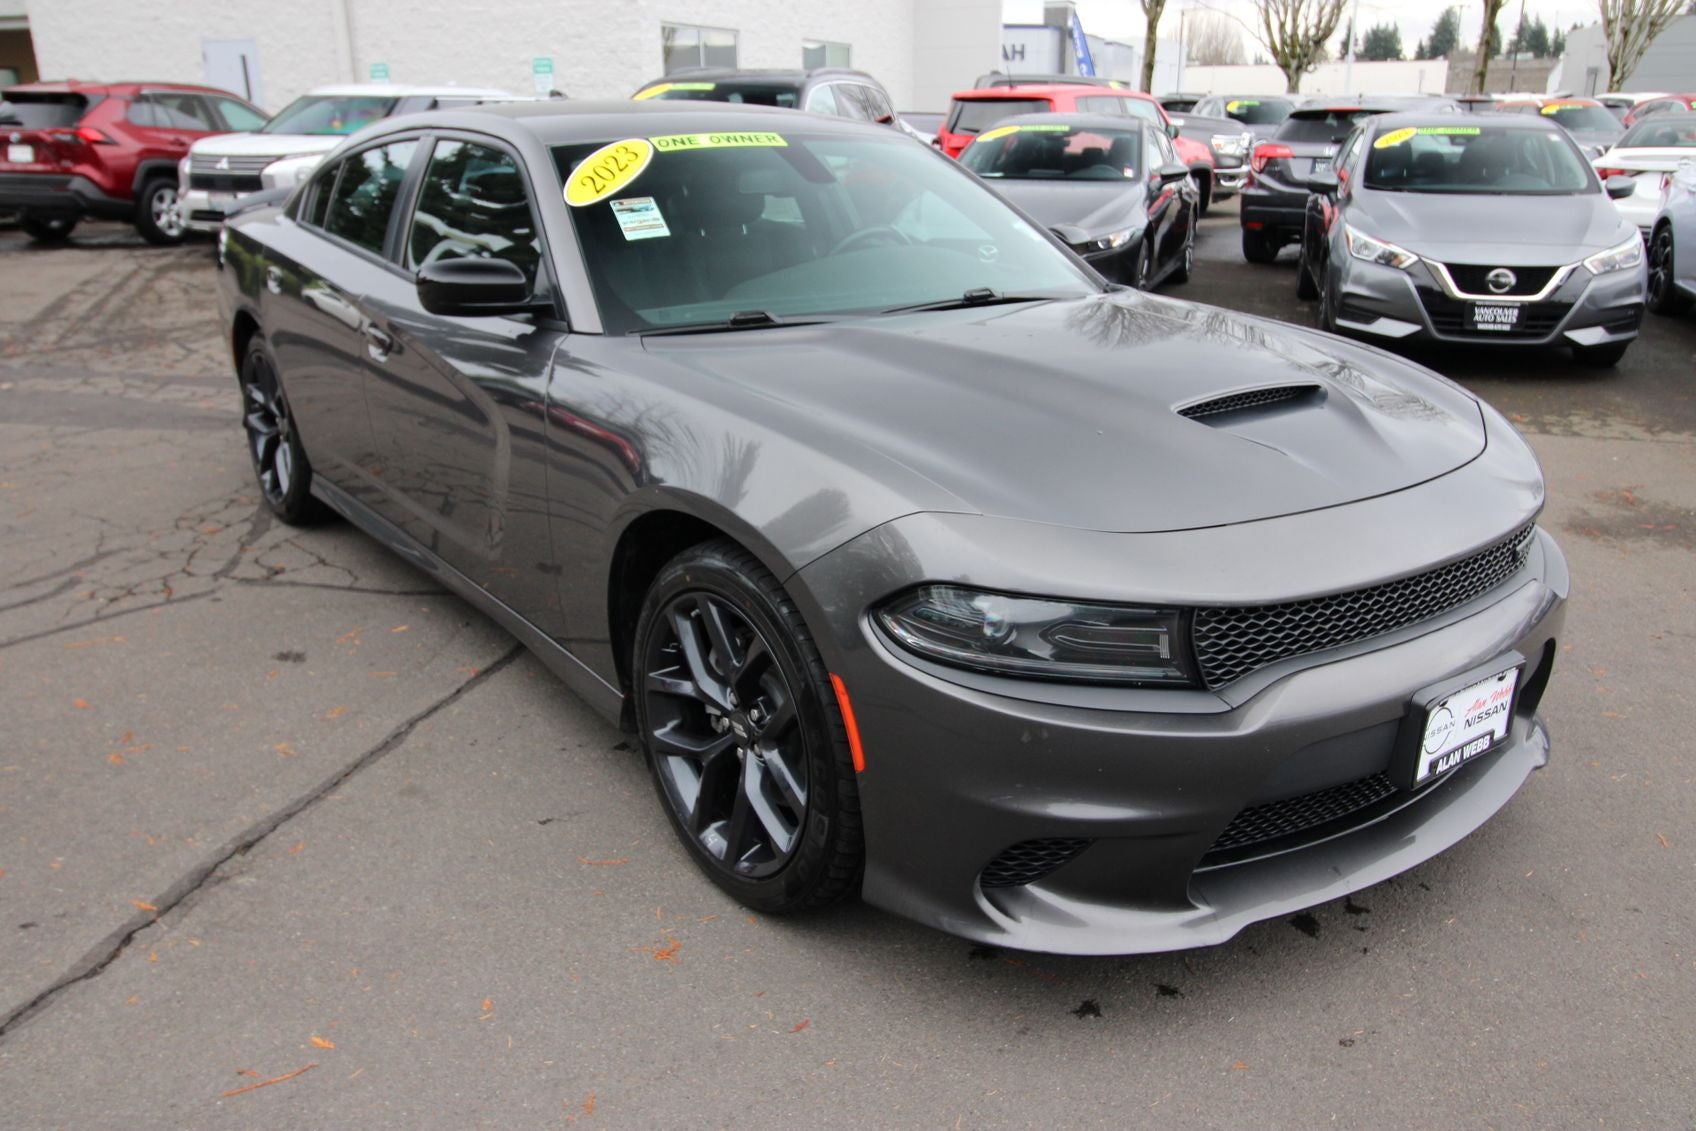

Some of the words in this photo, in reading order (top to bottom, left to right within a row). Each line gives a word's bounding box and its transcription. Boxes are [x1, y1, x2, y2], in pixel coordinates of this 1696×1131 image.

[657, 135, 699, 149] ONE
[708, 134, 780, 146] OWNER
[580, 145, 639, 195] 2023
[1473, 313, 1494, 322] AUTO
[1496, 315, 1517, 323] SALES
[1474, 307, 1519, 317] VANCOUVER
[1463, 700, 1508, 730] NISSAN
[1436, 748, 1462, 775] ALAN
[1462, 735, 1491, 760] WEBB
